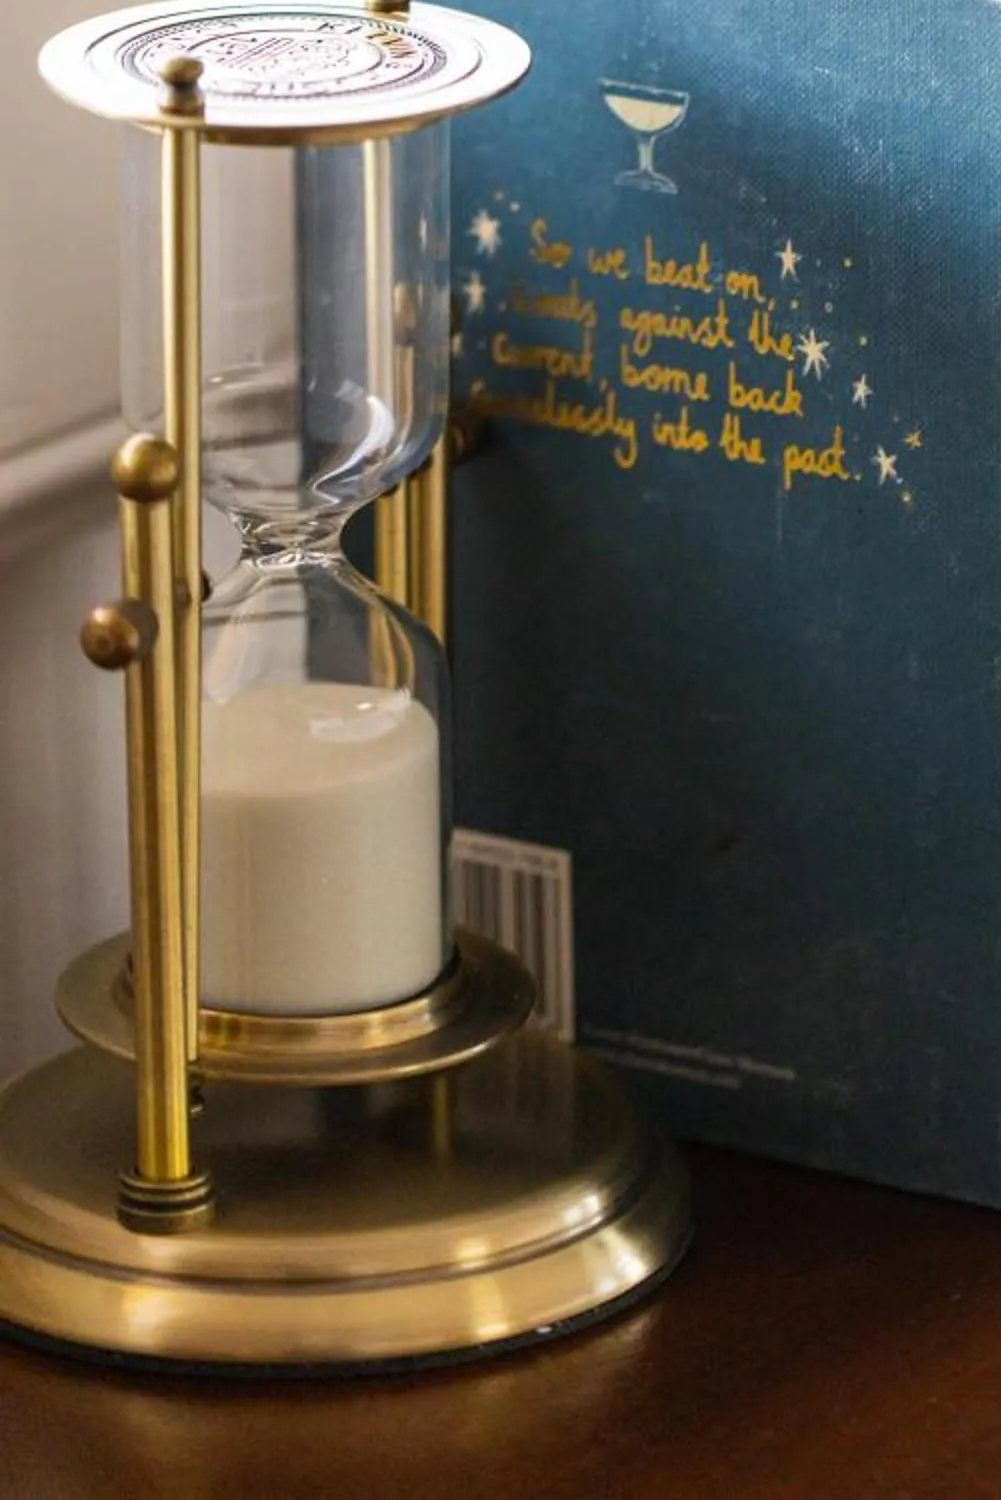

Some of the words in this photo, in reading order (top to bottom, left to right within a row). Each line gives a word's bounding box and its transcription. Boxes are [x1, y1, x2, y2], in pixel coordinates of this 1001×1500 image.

[529, 217, 573, 269] So
[587, 246, 630, 280] we
[644, 233, 713, 294] beat
[619, 297, 735, 357] against
[748, 307, 795, 362] the
[728, 359, 805, 418] back
[653, 405, 709, 453] into
[720, 412, 767, 465] the
